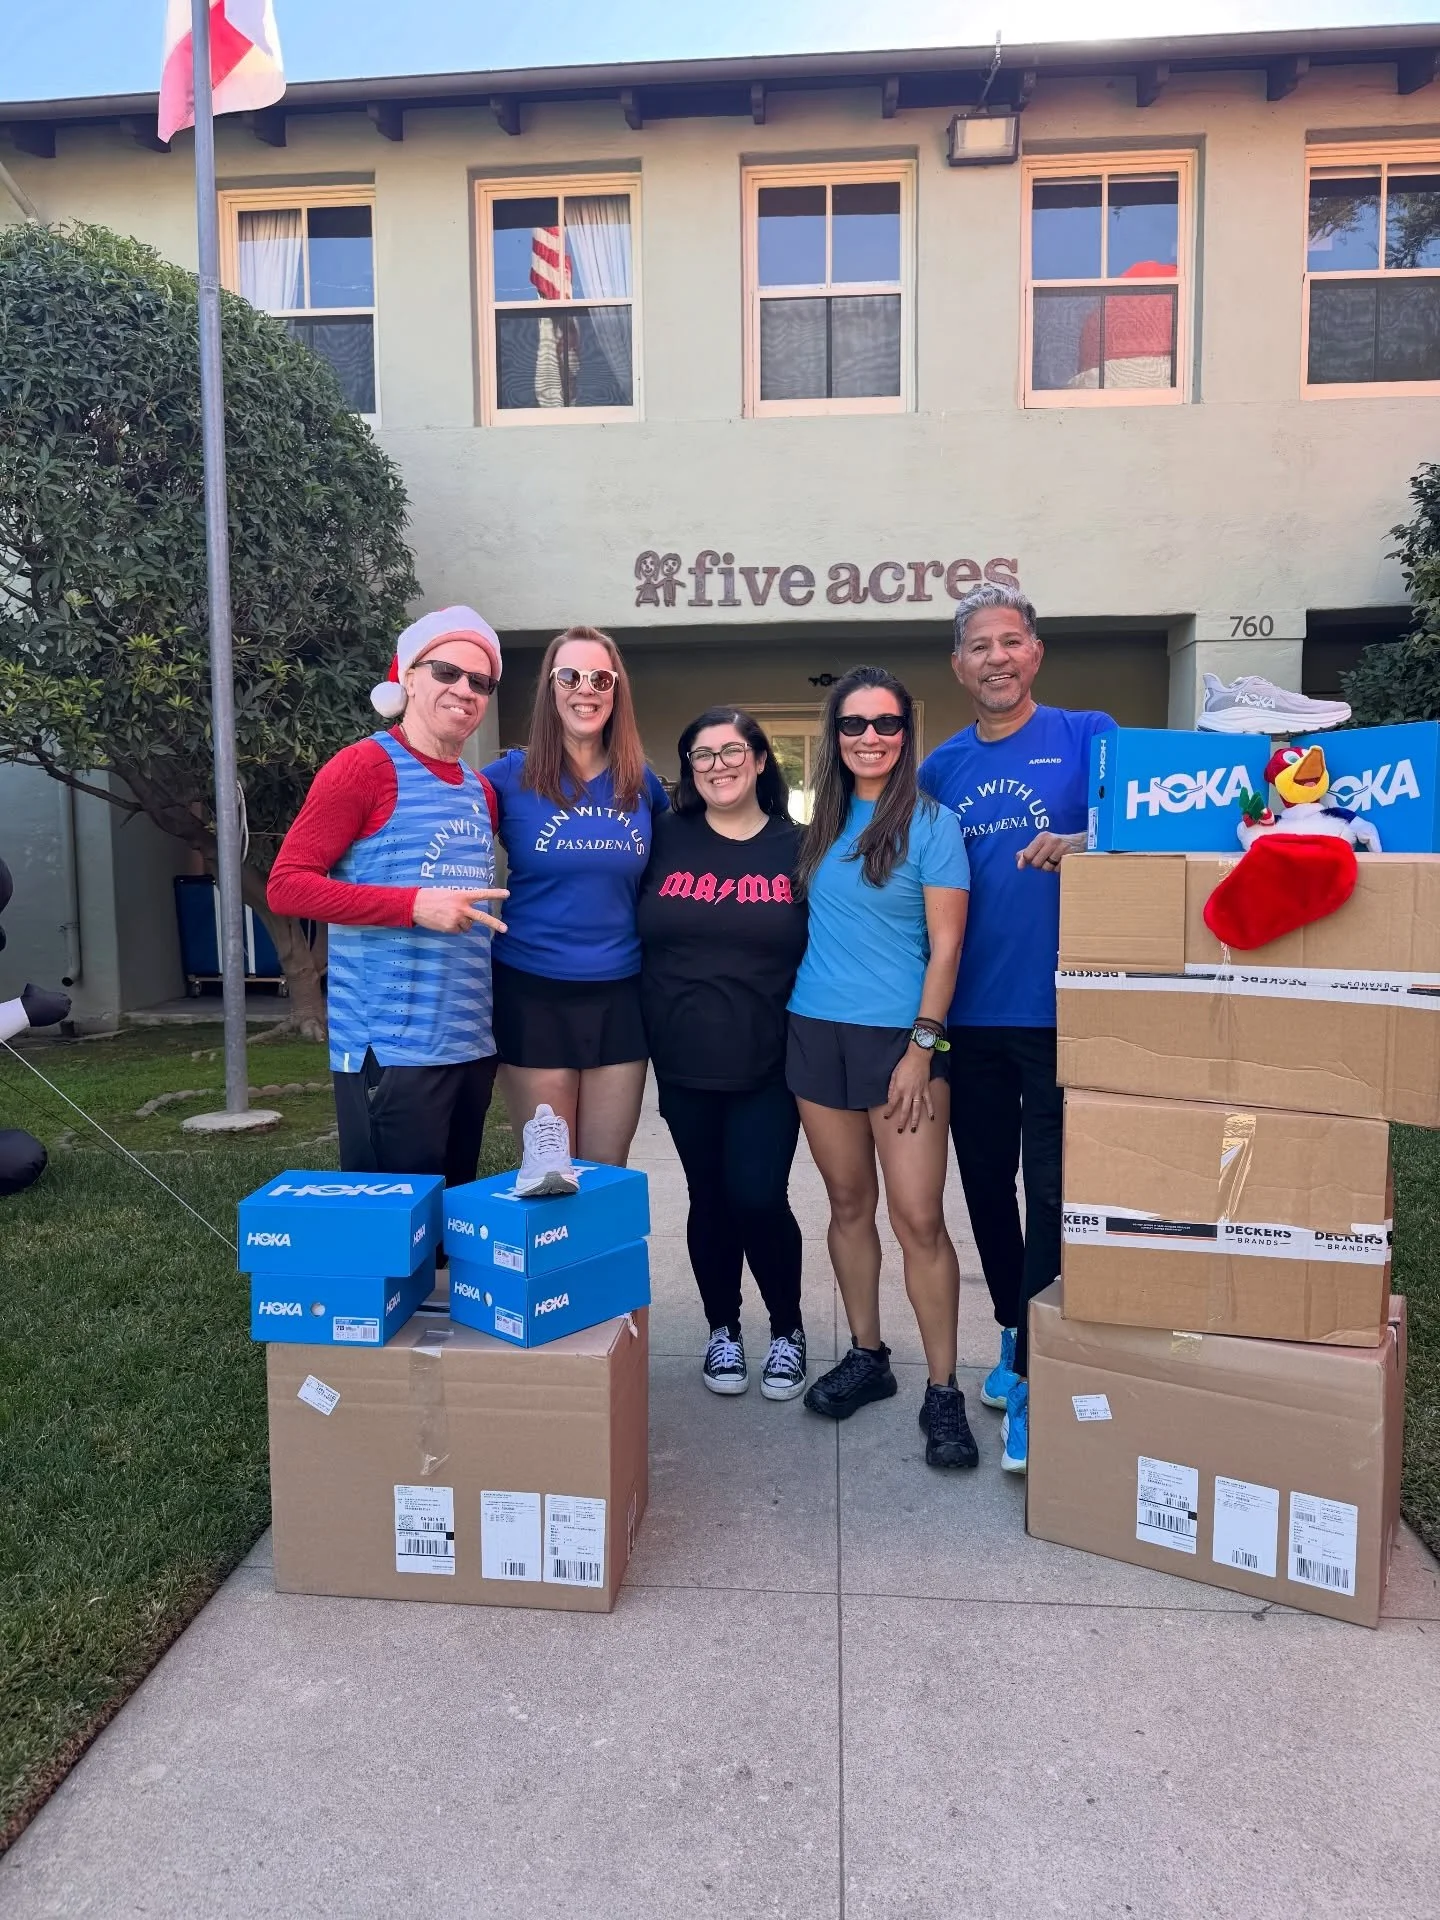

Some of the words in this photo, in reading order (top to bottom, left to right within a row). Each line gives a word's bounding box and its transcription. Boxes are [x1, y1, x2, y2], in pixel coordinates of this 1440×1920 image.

[688, 550, 815, 607] five
[826, 557, 1020, 604] acres
[1230, 615, 1273, 637] 760
[1234, 690, 1275, 709] HOKA
[1099, 739, 1107, 780] HOKA
[1126, 765, 1254, 819] HOKA
[1326, 759, 1421, 811] OKA
[976, 779, 1034, 801] WITH
[1029, 799, 1050, 830] US
[534, 810, 570, 853] RUN
[573, 806, 631, 828] WITH
[631, 829, 645, 856] US
[962, 816, 1029, 838] PASADENA
[421, 827, 451, 879] RUN
[449, 818, 491, 853] WITH
[555, 839, 631, 852] PASADENA
[267, 1184, 414, 1197] HOKA
[413, 1223, 426, 1248] HOKA
[447, 1217, 475, 1237] HOKA
[534, 1225, 569, 1249] HOKA
[1225, 1225, 1292, 1239] DECKERS
[246, 1232, 292, 1247] HOKA
[1237, 1237, 1279, 1246] BRANDS
[1327, 1243, 1370, 1253] BRANDS
[454, 1281, 481, 1302] HOKA
[258, 1301, 303, 1317] HOKA
[534, 1292, 570, 1318] HOKA
